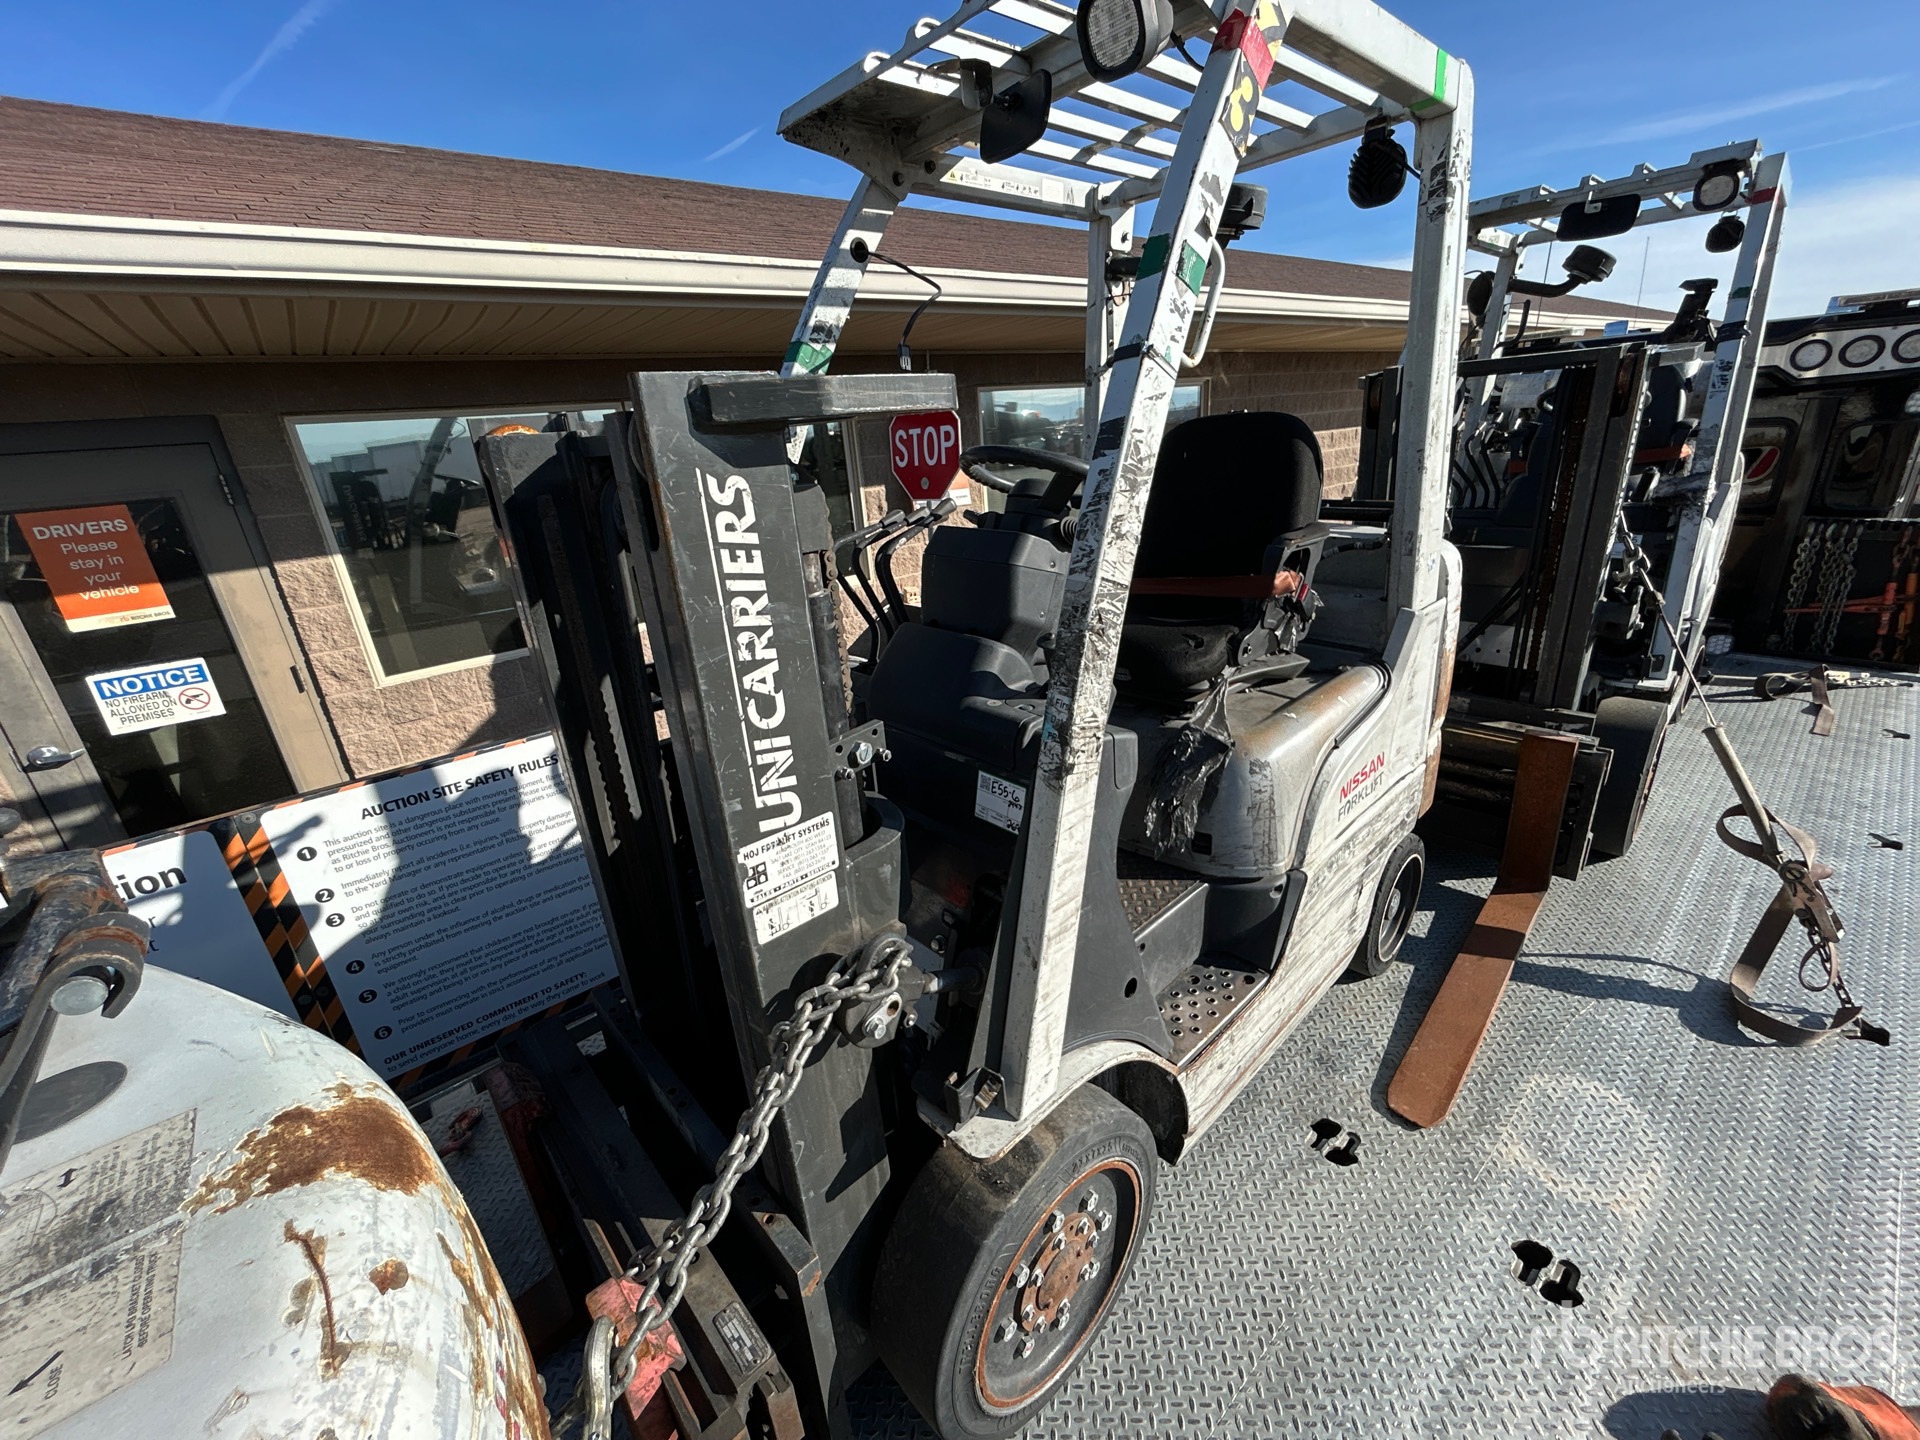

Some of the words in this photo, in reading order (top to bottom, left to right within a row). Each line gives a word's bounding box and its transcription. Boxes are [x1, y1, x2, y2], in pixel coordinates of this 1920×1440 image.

[895, 425, 955, 467] STOP
[32, 518, 128, 540] DRIVERS
[60, 541, 118, 555] Please
[69, 557, 104, 570] stay
[109, 554, 124, 566] in
[84, 571, 122, 587] your
[79, 584, 140, 601] vehicle
[706, 474, 802, 833] UNICARRIERS
[100, 666, 204, 698] NOTICE
[105, 700, 121, 708] NO
[110, 702, 160, 718] ALLOWED
[162, 698, 178, 708] ON
[120, 708, 175, 725] PREMISES
[362, 790, 431, 820] AUCTION
[432, 781, 463, 799] SITE
[465, 766, 515, 790] SAFETY
[518, 754, 558, 774] RULES
[991, 781, 1020, 802] E55-6
[1337, 771, 1385, 823] FORKLIFT
[1339, 751, 1385, 803] NISSAN
[322, 837, 340, 848] This
[341, 828, 372, 842] auction
[373, 823, 388, 833] site
[388, 820, 397, 828] is
[403, 807, 443, 824] dangerous
[444, 801, 464, 813] place
[464, 794, 481, 806] with
[481, 788, 508, 800] moving
[326, 836, 373, 858] pressurized
[374, 831, 390, 842] and
[390, 825, 412, 837] other
[411, 814, 451, 830] dangerous
[452, 802, 490, 818] substances
[518, 786, 540, 798] Please
[539, 783, 552, 791] use
[330, 856, 340, 864] as
[340, 847, 370, 861] Ritchie
[370, 841, 392, 852] Bros.
[391, 827, 435, 845] Auctioneers
[435, 824, 444, 832] is
[443, 819, 456, 829] not
[457, 807, 497, 825] responsible
[497, 805, 507, 813] for
[507, 801, 521, 810] any
[521, 793, 544, 805] injuries
[333, 865, 344, 873] to
[344, 862, 354, 870] or
[354, 856, 371, 866] loss
[372, 852, 381, 861] of
[382, 842, 415, 860] property
[447, 827, 465, 837] from
[465, 822, 480, 831] any
[340, 868, 391, 890] Immediately
[391, 859, 414, 873] report
[415, 856, 425, 865] all
[425, 846, 458, 862] incidents
[519, 817, 546, 833] property
[545, 809, 572, 822] damage
[743, 848, 759, 861] HOJ
[798, 818, 830, 838] SYSTEMS
[343, 890, 354, 898] to
[354, 885, 369, 894] the
[369, 877, 387, 889] Yard
[388, 866, 423, 882] Manager
[423, 863, 432, 871] or
[432, 859, 447, 868] any
[447, 842, 496, 863] representative
[496, 838, 505, 847] of
[364, 930, 391, 945] always
[391, 918, 425, 934] maintain
[432, 904, 461, 920] lookout.
[369, 950, 387, 960] Any
[387, 940, 413, 955] person
[413, 931, 436, 943] under
[435, 926, 448, 935] the
[448, 914, 481, 930] influence
[481, 910, 489, 918] of
[515, 894, 534, 905] drugs
[542, 878, 576, 895] medication
[382, 1049, 407, 1065] OUR
[408, 1020, 474, 1054] UNRESERVED
[475, 991, 539, 1024] COMMITMENT
[540, 985, 552, 996] TO
[553, 970, 587, 990] SAFETY:
[397, 1054, 418, 1068] send
[418, 1038, 456, 1058] everyone
[480, 1018, 501, 1031] every
[516, 1006, 529, 1015] the
[530, 999, 545, 1009] way
[544, 991, 562, 1002] they
[561, 983, 580, 995] came
[589, 970, 605, 982] work
[128, 1284, 141, 1316] BRACKET
[141, 1274, 155, 1315] OPERATING
[137, 1314, 150, 1347] BEFORE
[45, 1363, 62, 1401] CLOSE
